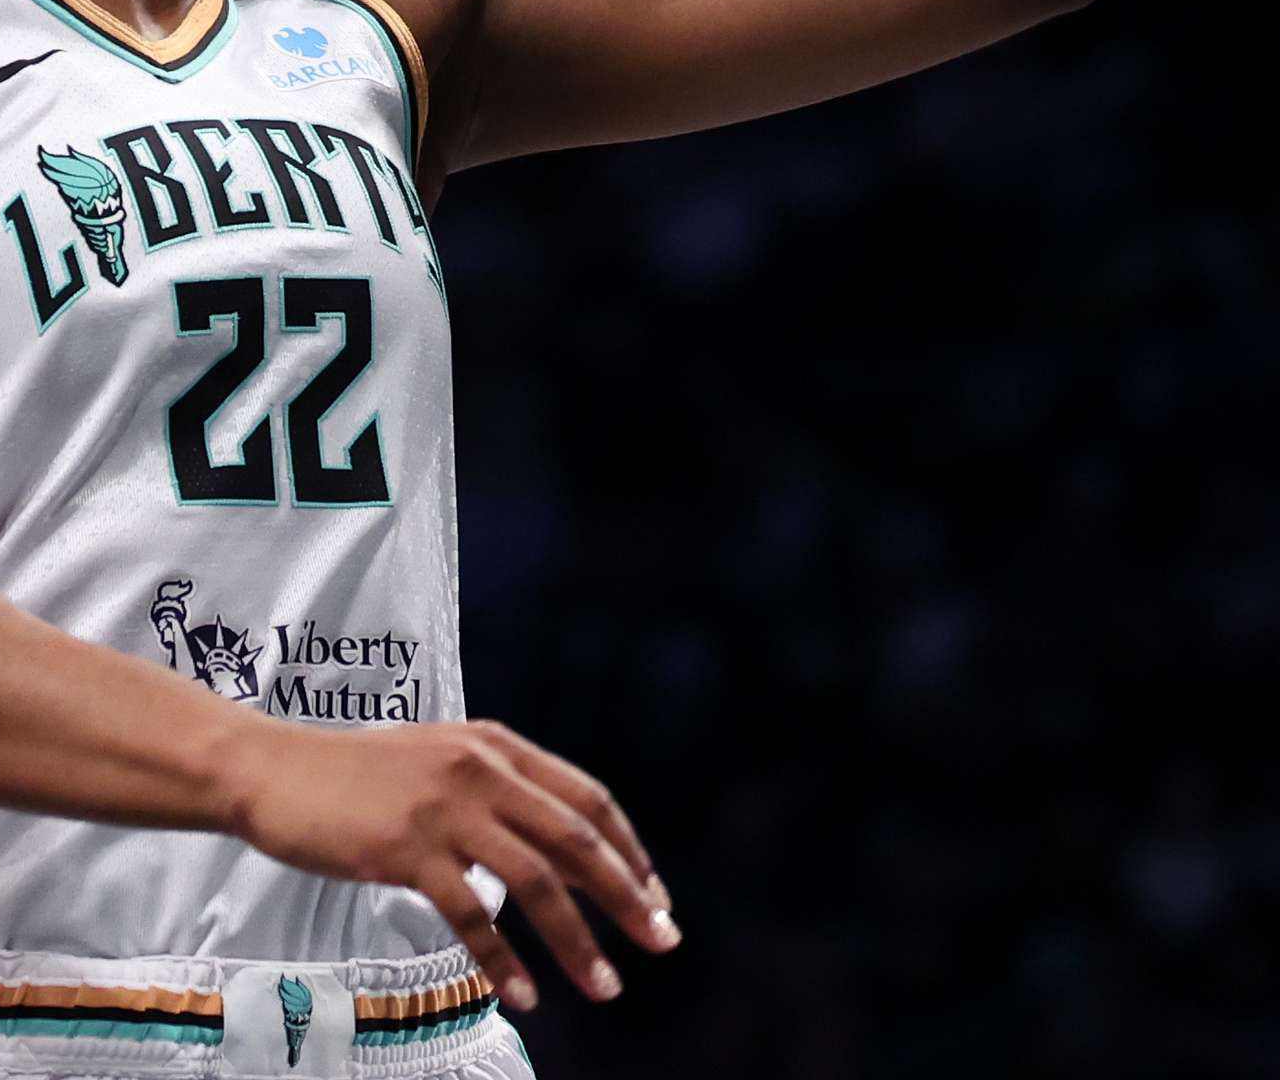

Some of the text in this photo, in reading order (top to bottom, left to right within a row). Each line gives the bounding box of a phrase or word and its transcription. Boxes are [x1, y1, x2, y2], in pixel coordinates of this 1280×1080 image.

[269, 56, 382, 89] BARCLAY
[165, 272, 394, 509] 22
[271, 619, 420, 688] Liberty
[266, 675, 420, 724] Mutual
